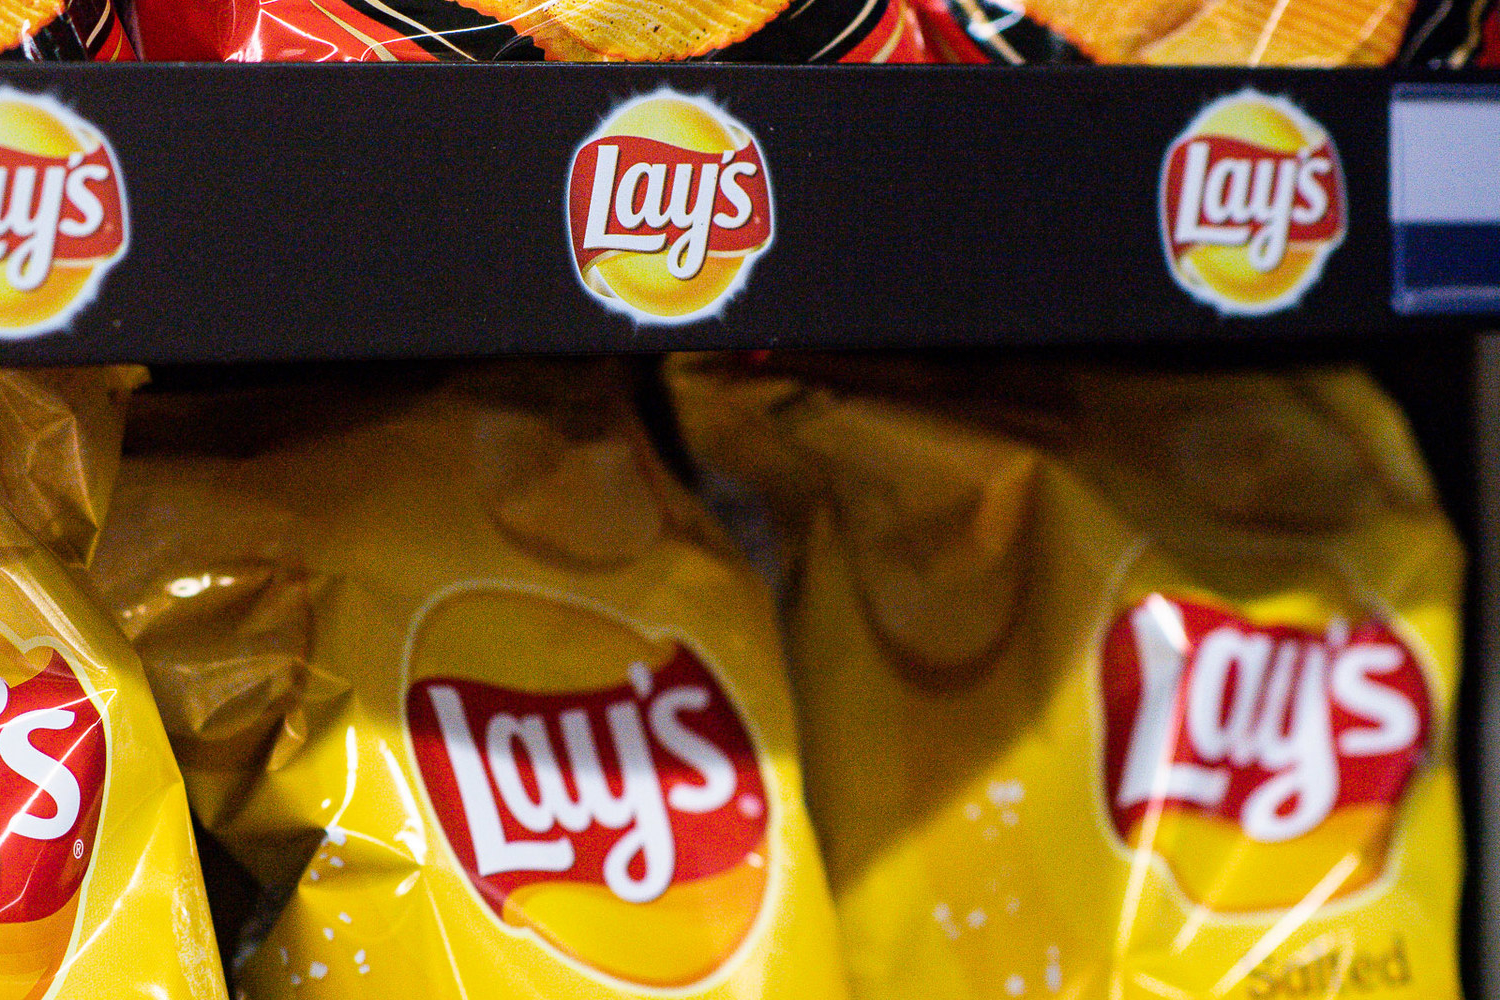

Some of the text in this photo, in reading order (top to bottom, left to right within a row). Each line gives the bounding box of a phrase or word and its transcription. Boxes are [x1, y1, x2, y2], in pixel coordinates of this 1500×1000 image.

[583, 145, 757, 279] Lay's
[1174, 142, 1330, 272] Lay's
[428, 660, 737, 902] Lay's
[1118, 593, 1421, 842] Lay's
